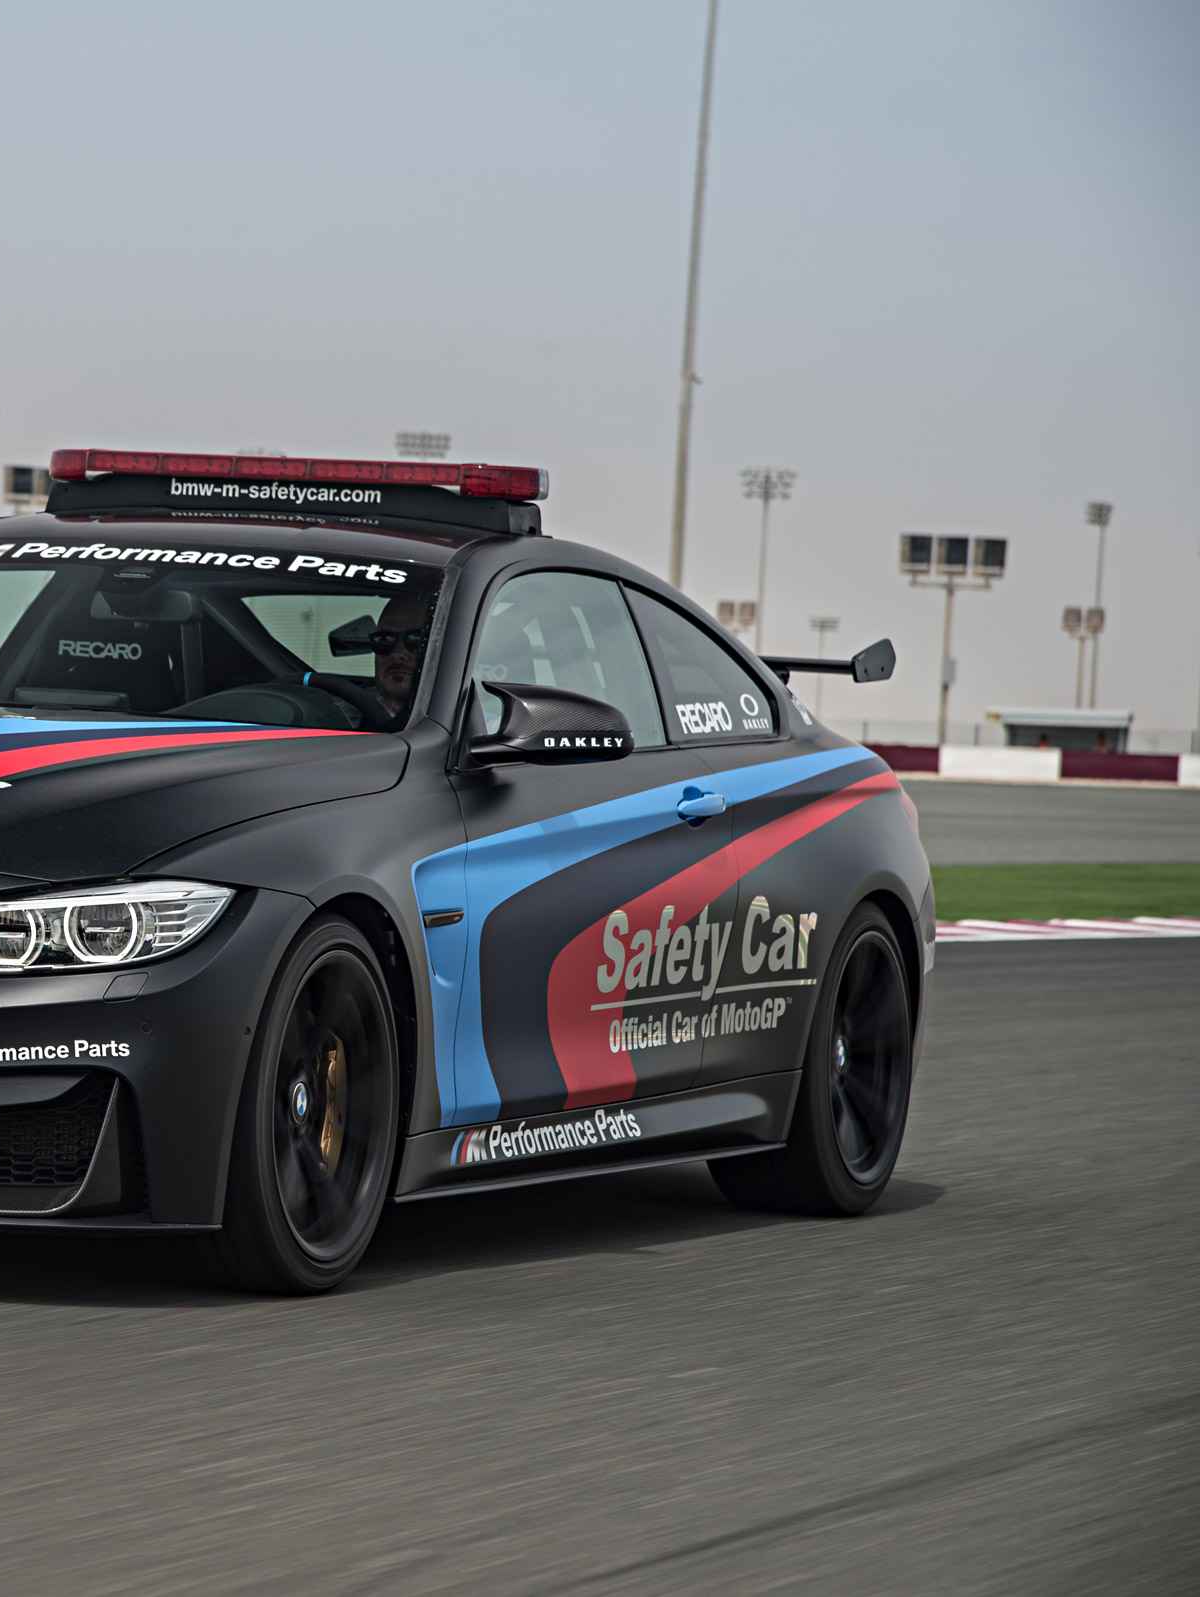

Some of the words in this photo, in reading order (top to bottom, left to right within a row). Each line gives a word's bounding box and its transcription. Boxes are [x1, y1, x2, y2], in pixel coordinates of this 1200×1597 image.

[170, 478, 382, 504] bmw-m-safetycar.com
[11, 543, 281, 570] Performance
[287, 555, 408, 584] Parts
[57, 639, 143, 661] RECARO
[675, 701, 733, 735] RECARO
[742, 718, 770, 730] OAKLEY
[543, 737, 624, 748] OAKLEY
[596, 904, 733, 1001] Safety
[741, 895, 818, 975] Car
[609, 1013, 668, 1054] Official
[671, 1010, 699, 1044] Car
[701, 1003, 718, 1039] of
[74, 1039, 131, 1058] Parts
[488, 1119, 598, 1160] Performance
[594, 1108, 642, 1142] Parts
